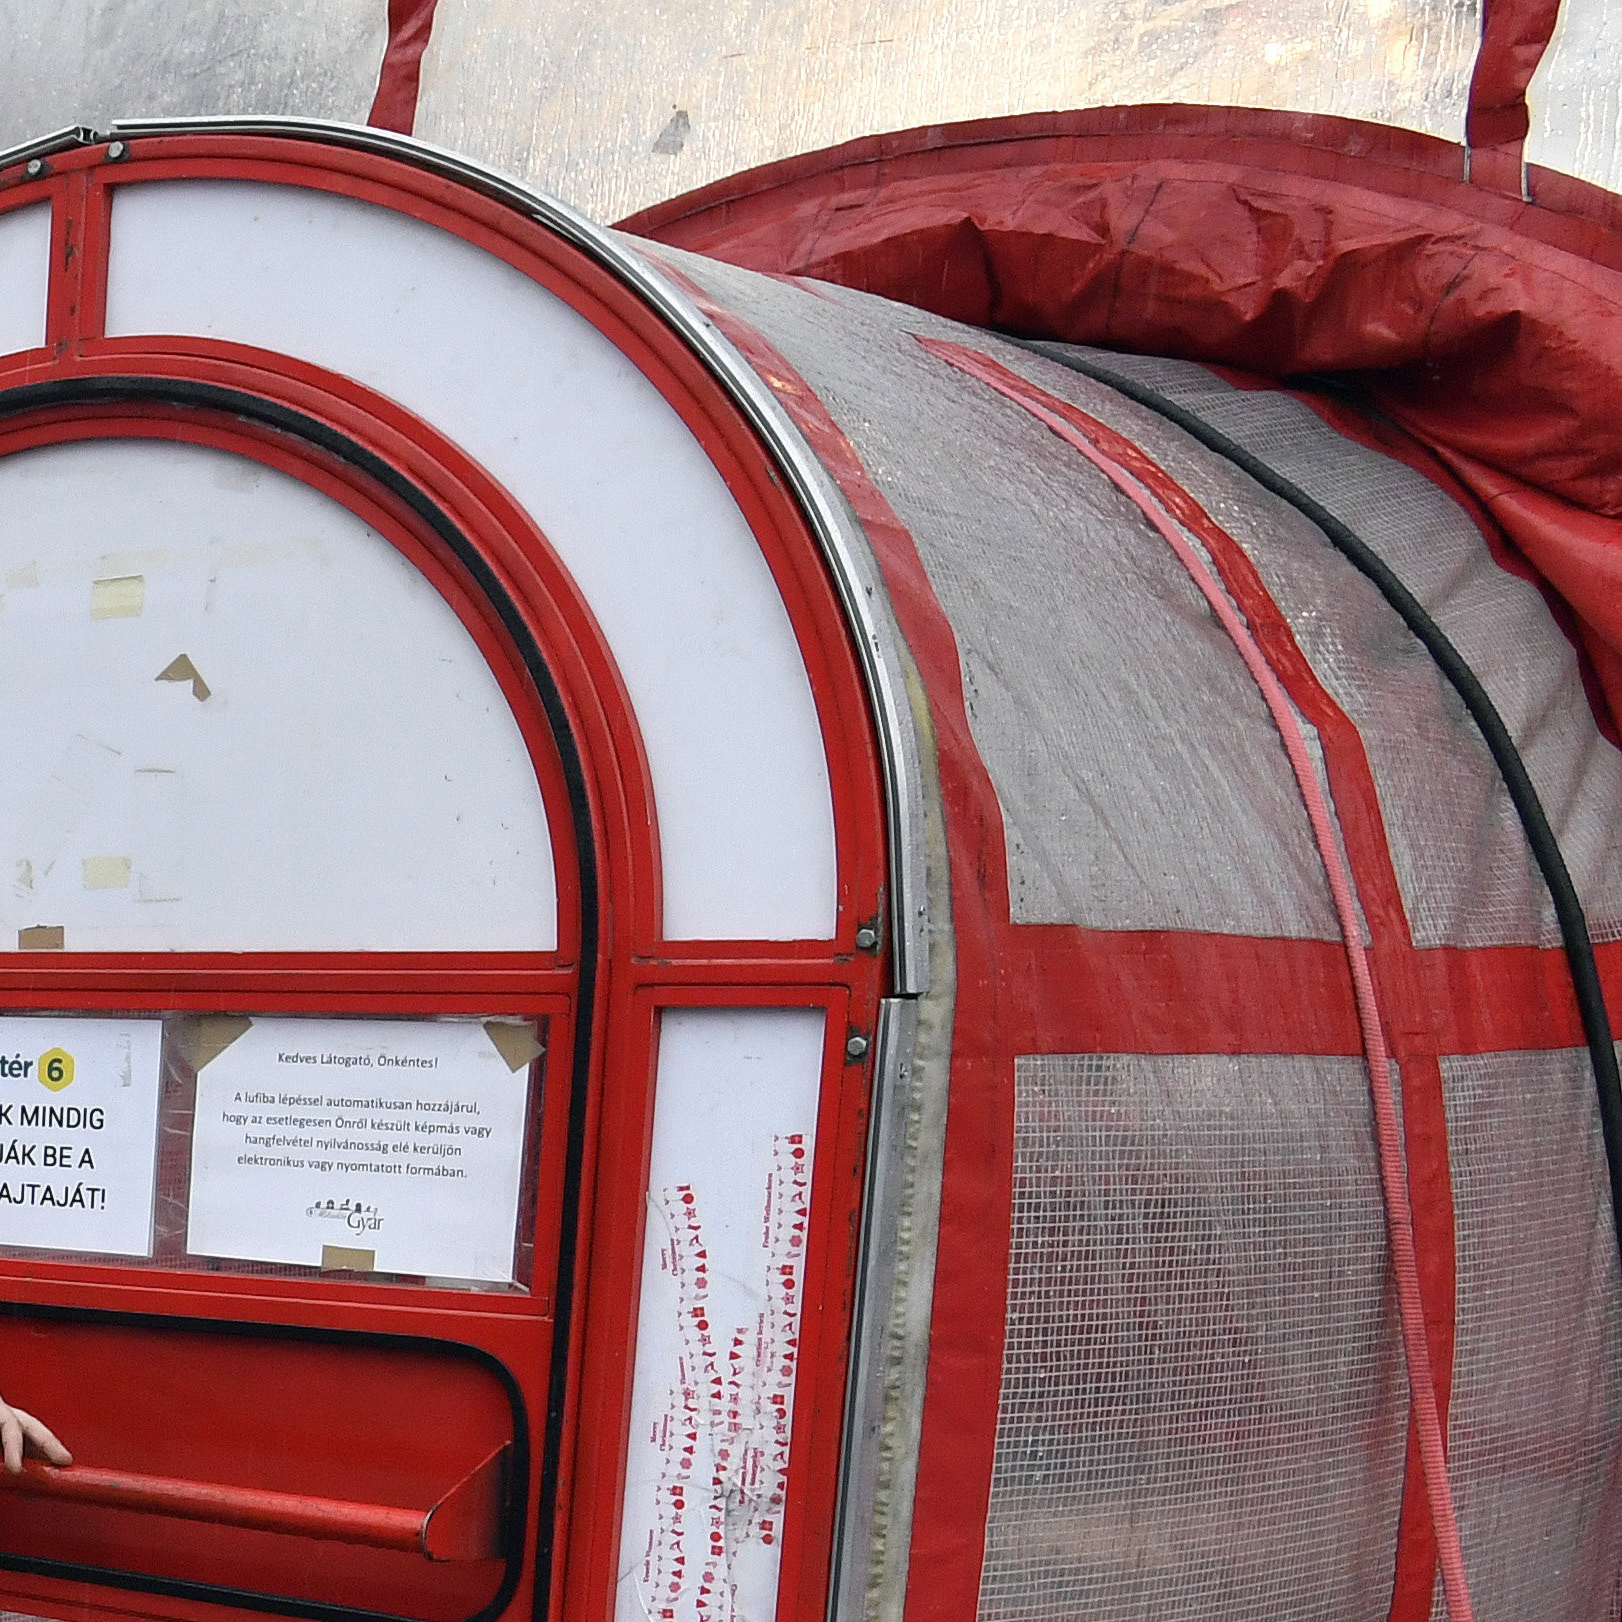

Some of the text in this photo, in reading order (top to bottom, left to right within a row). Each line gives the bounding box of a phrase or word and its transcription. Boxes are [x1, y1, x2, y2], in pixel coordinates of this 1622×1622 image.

[278, 1052, 438, 1069] Kedves Látogató, Önkéntes!
[234, 1092, 481, 1115] A lufiba lépéssel automatikusan hozzájárul,
[20, 1104, 105, 1130] MINDIG
[222, 1111, 493, 1138] hogy az esetlegesen Önről készült képmás vagy
[43, 1145, 73, 1168] BE
[78, 1148, 95, 1170] A
[244, 1133, 462, 1158] hangfelvétel nyilvánosság elé kerüljön
[237, 1154, 467, 1178] elektronikus vagy nyomtatott formában.
